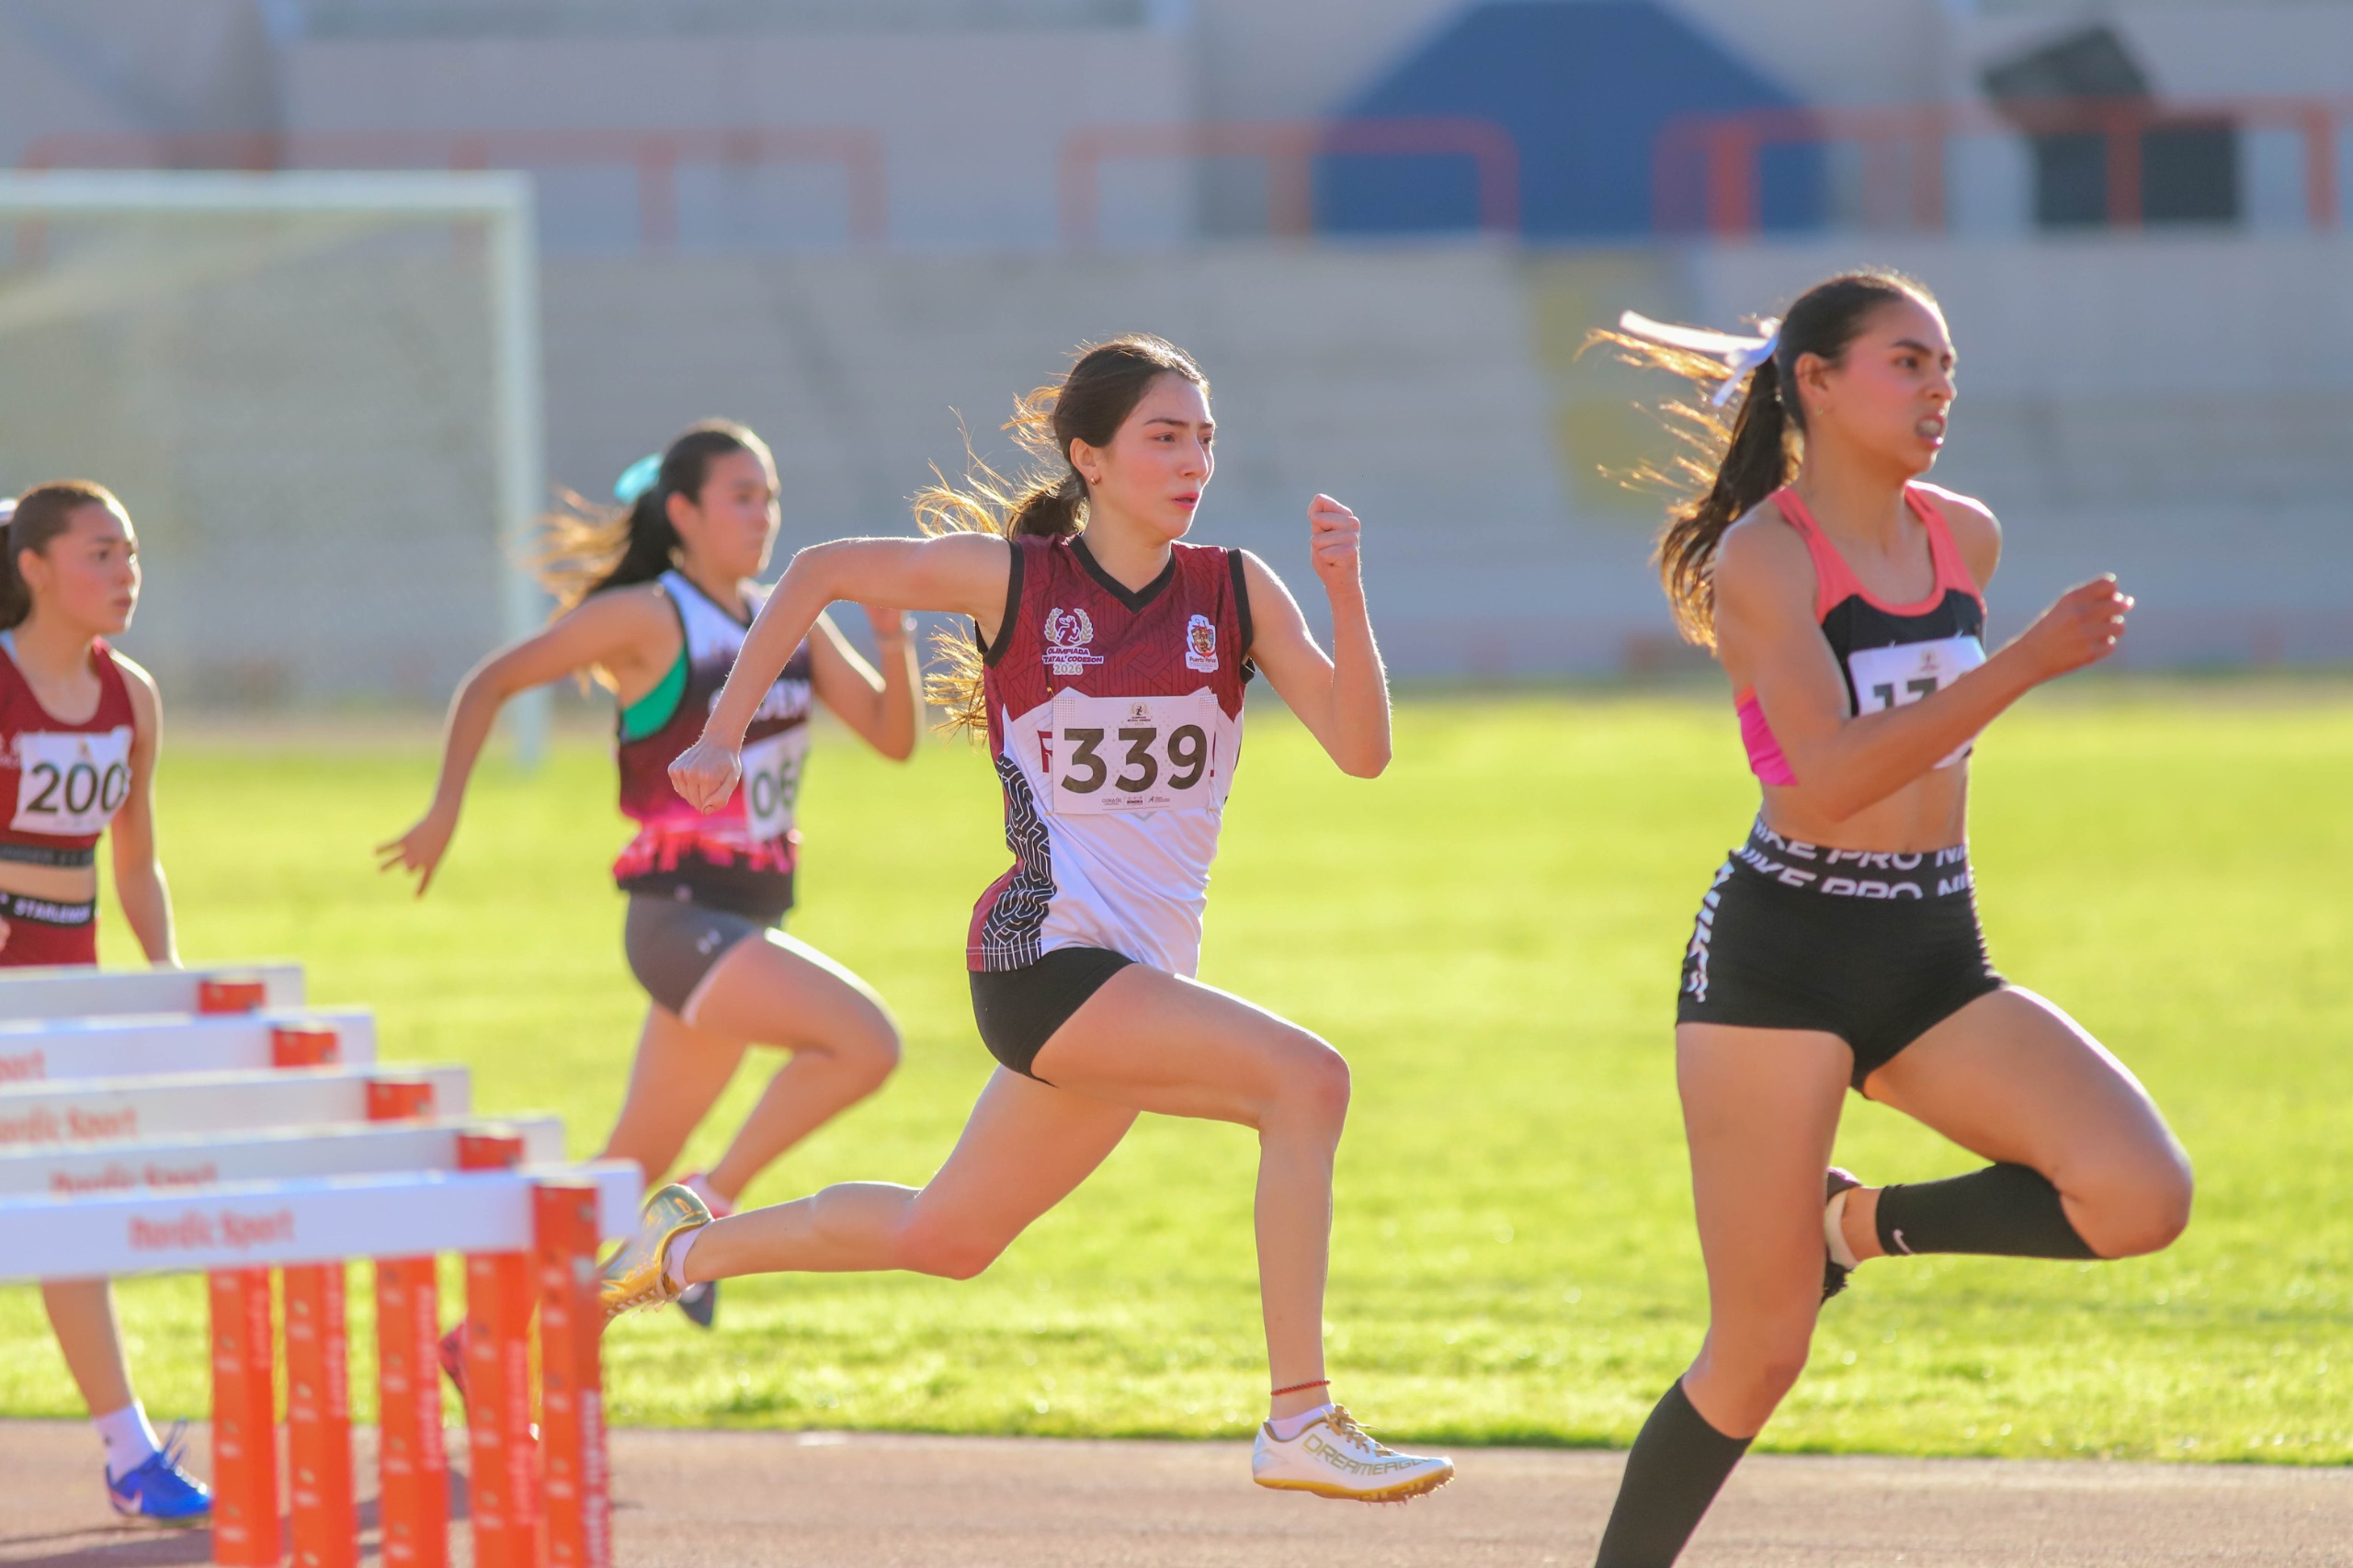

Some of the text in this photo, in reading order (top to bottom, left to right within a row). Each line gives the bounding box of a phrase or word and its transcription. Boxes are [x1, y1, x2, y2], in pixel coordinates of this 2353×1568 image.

[1048, 647, 1089, 655] OLIMPIADA
[1053, 664, 1083, 674] 2026
[1061, 723, 1208, 794] 339
[26, 762, 127, 814] 200
[752, 751, 811, 819] 06
